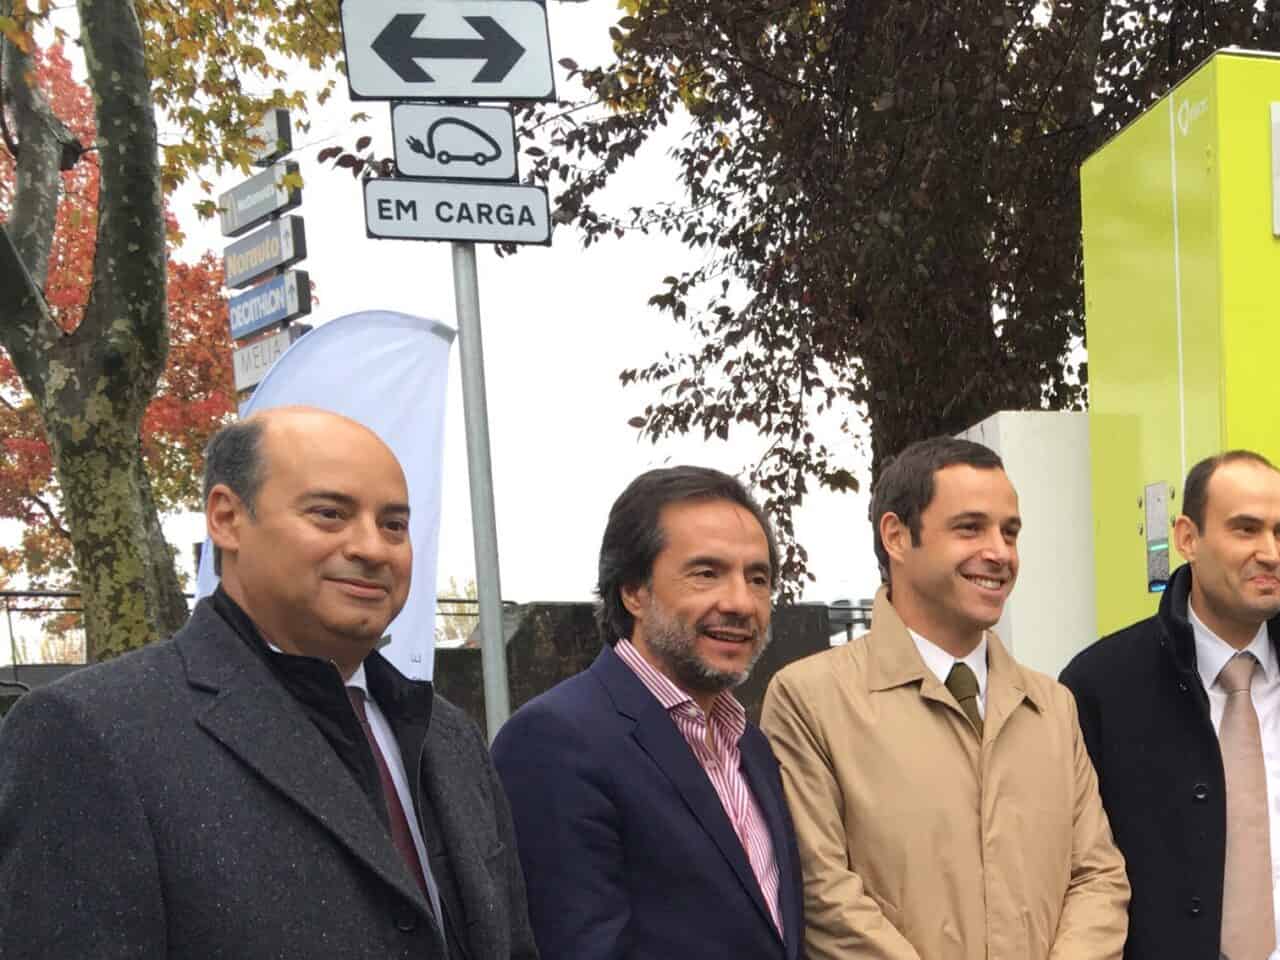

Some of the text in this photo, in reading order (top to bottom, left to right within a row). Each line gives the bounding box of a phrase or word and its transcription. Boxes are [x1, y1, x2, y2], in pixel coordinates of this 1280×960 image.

[376, 198, 536, 227] EM CARGA
[231, 287, 285, 328] DECATHLON
